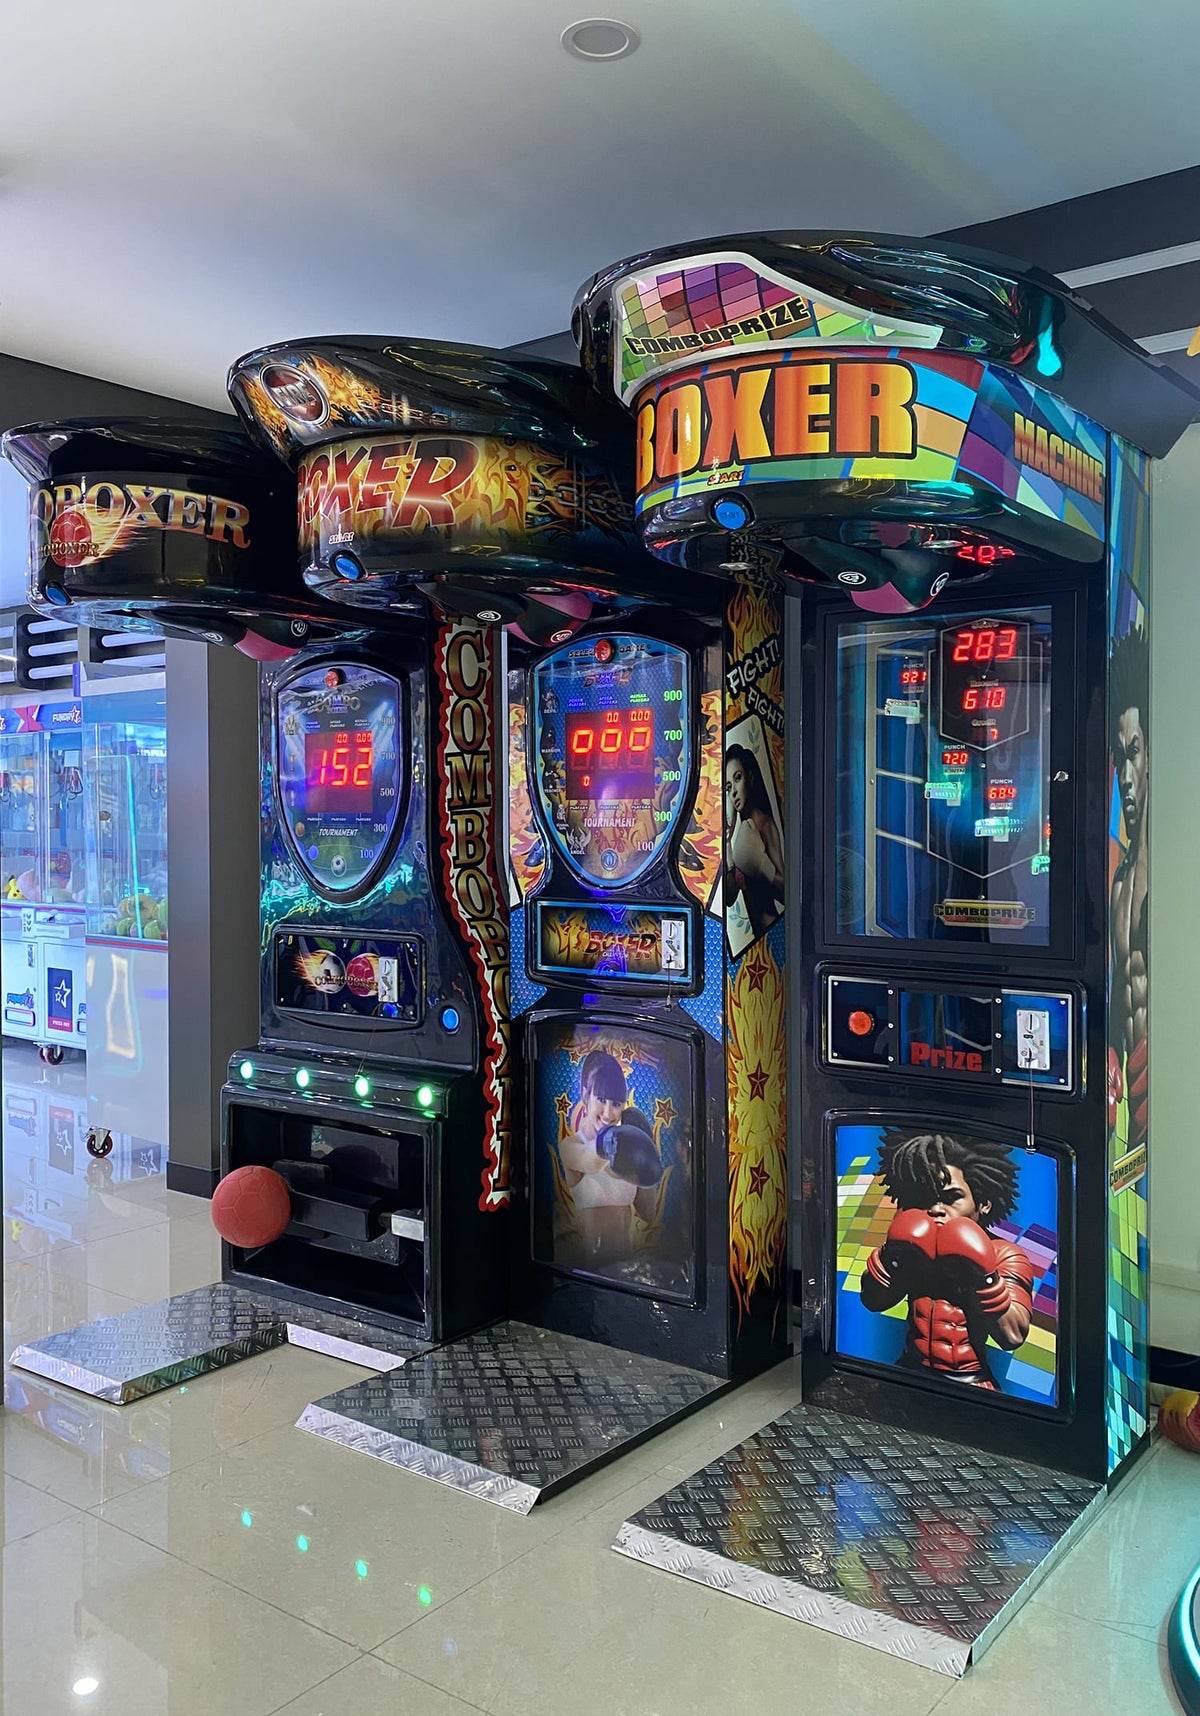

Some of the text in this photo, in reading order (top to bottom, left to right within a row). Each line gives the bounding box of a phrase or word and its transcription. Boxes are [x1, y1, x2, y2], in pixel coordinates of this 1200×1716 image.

[625, 296, 811, 356] COMBOPRIZE
[637, 359, 917, 494] BOXER
[1014, 411, 1104, 505] MACHINE
[953, 628, 1017, 661] 283
[727, 639, 781, 694] FIGHT!
[902, 672, 927, 684] 921
[664, 690, 683, 702] 900
[964, 687, 1005, 710] 610
[748, 687, 785, 733] FIGHT!
[664, 730, 683, 741] 700
[990, 728, 998, 740] 7
[943, 753, 969, 766] 720
[319, 747, 373, 786] 152
[583, 775, 590, 787] 0
[663, 770, 681, 782] 500
[380, 788, 395, 797] 500
[989, 786, 1016, 799] 684
[583, 818, 636, 827] TOURNAMENT
[654, 811, 672, 822] 300
[319, 828, 359, 837] TOURNAMENT
[373, 824, 388, 832] 300
[637, 841, 654, 851] 100
[360, 849, 374, 858] 100
[933, 904, 1037, 921] COMBOPRIZE
[911, 1041, 983, 1072] Prize
